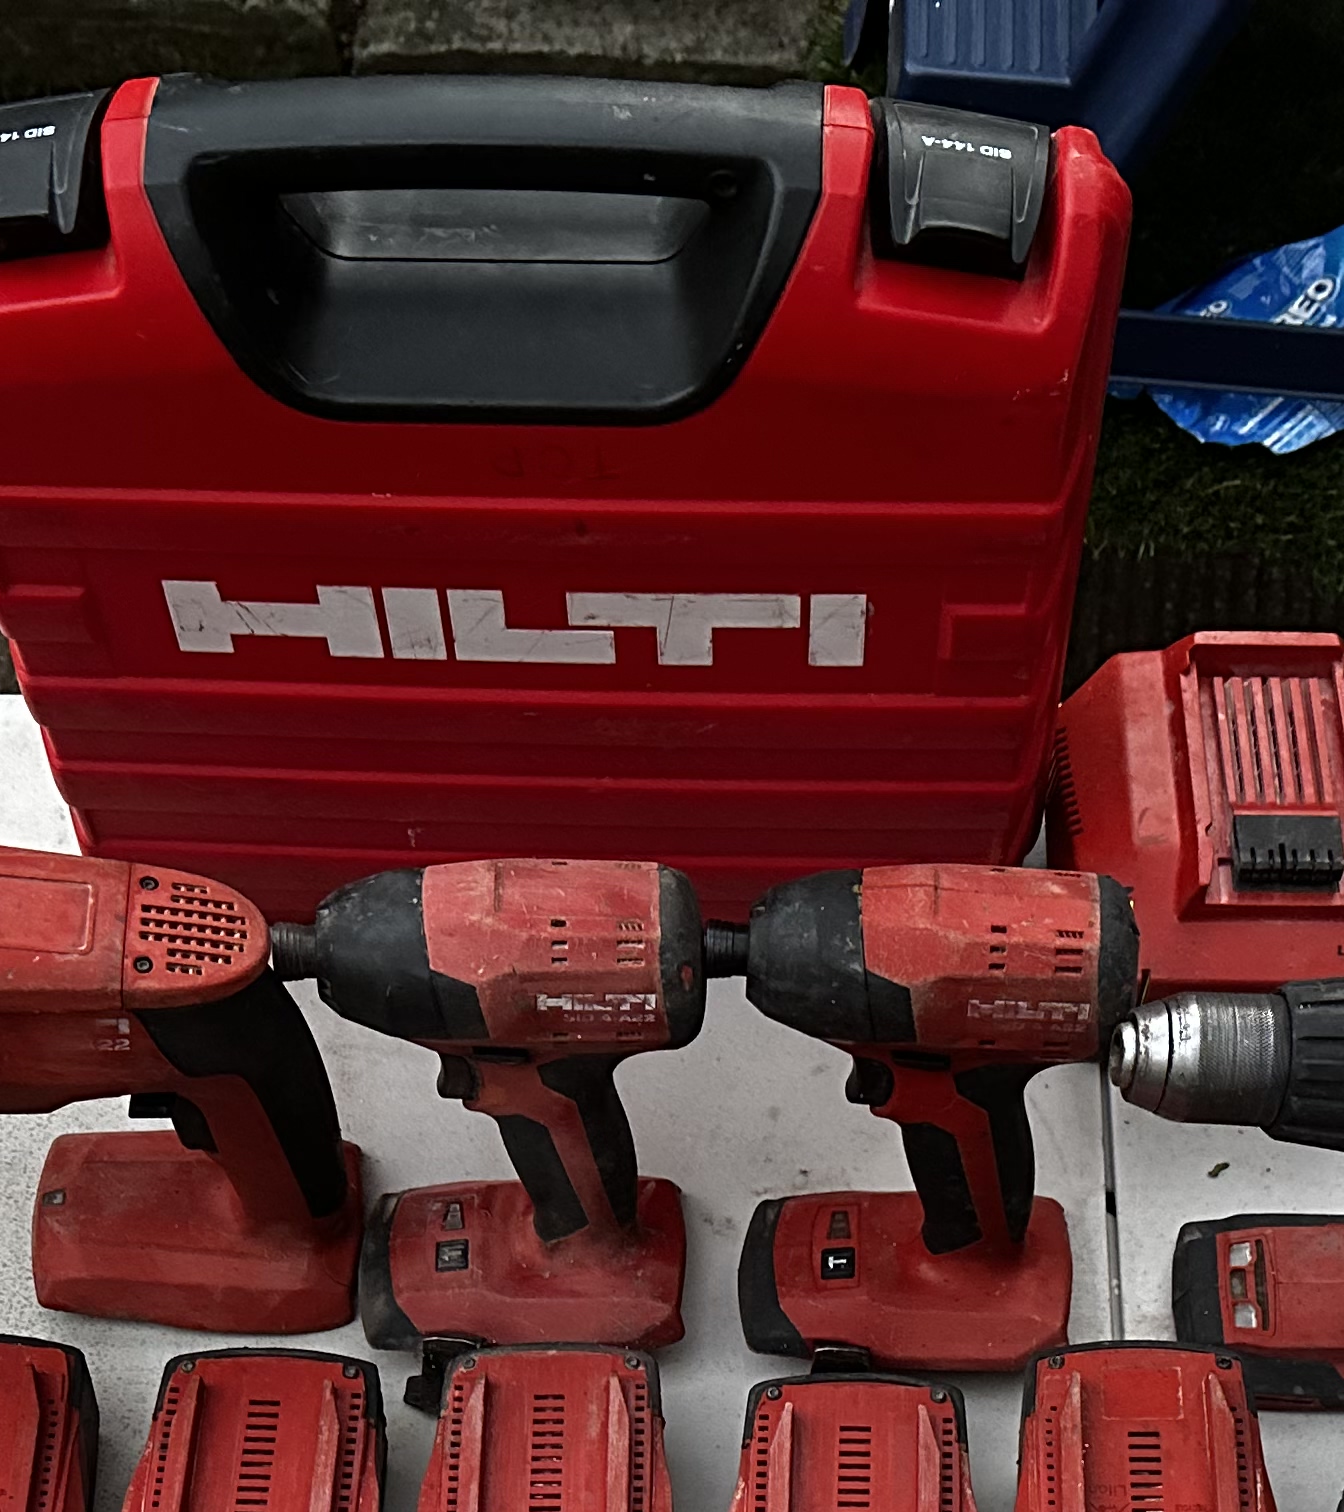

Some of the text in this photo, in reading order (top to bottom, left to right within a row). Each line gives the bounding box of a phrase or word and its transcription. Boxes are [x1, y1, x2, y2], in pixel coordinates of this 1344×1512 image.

[24, 126, 56, 139] SID
[921, 135, 1012, 160] SID 144-A
[161, 579, 867, 667] HILTI
